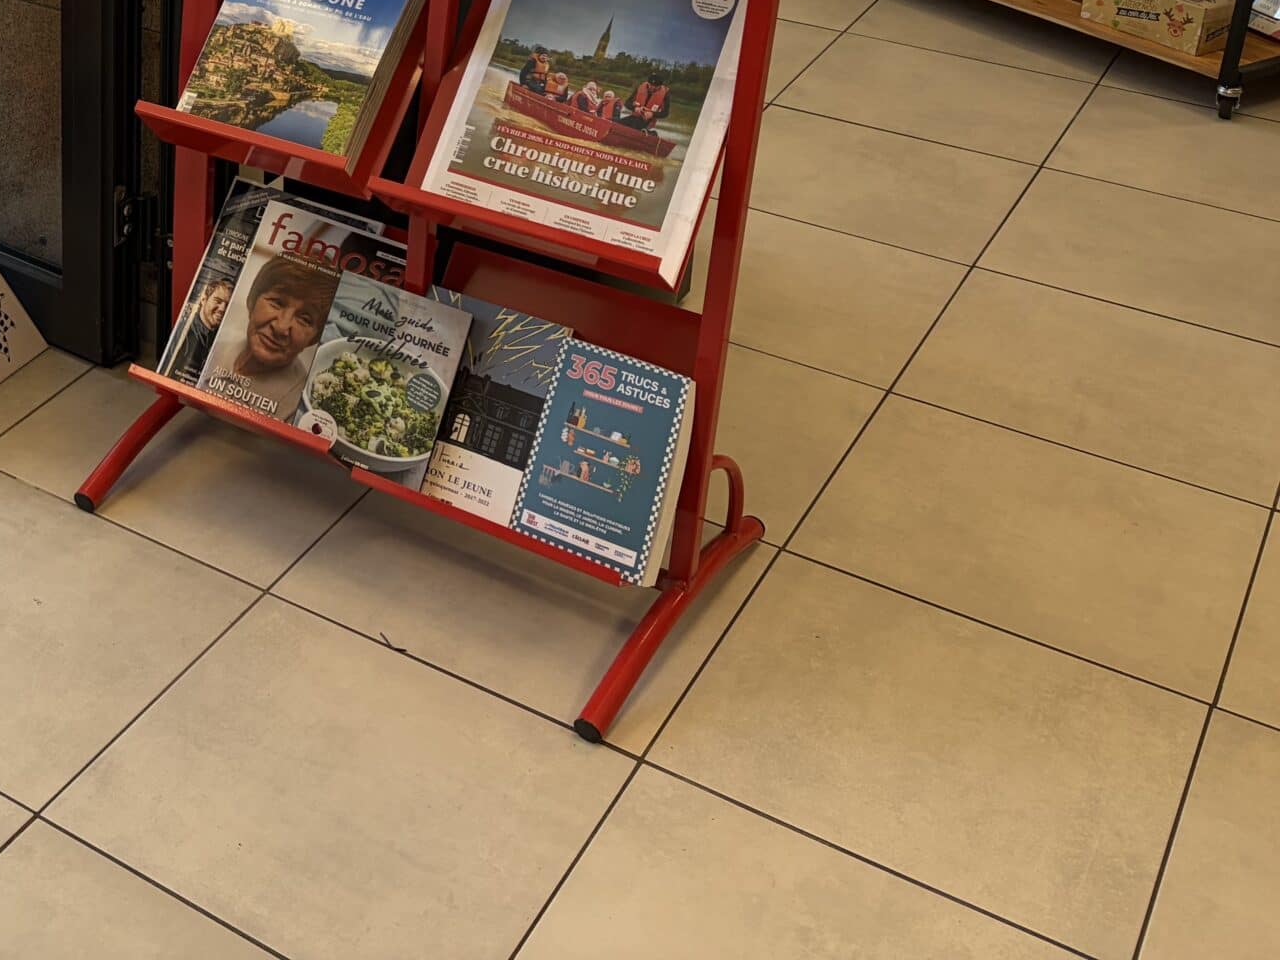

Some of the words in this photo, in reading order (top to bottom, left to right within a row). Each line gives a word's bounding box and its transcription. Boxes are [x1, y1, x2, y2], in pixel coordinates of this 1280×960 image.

[490, 136, 595, 177] Chronique
[598, 166, 656, 193] d'une
[483, 155, 530, 178] crue
[530, 163, 638, 209] historique
[218, 248, 227, 257] de
[221, 237, 230, 247] Le
[230, 241, 245, 254] pari
[340, 310, 370, 327] POUR
[372, 322, 396, 337] UNE
[397, 331, 451, 357] JOURNÉE
[394, 315, 435, 333] guide
[347, 332, 429, 369] équilibrée
[212, 366, 252, 387] AIDANTS
[567, 353, 618, 391] 365
[620, 369, 659, 392] TRUCS
[208, 377, 226, 392] UN
[228, 385, 278, 414] SOUTIEN
[617, 383, 671, 409] ASTUCES
[448, 473, 461, 486] LE
[461, 478, 494, 499] JEUNE
